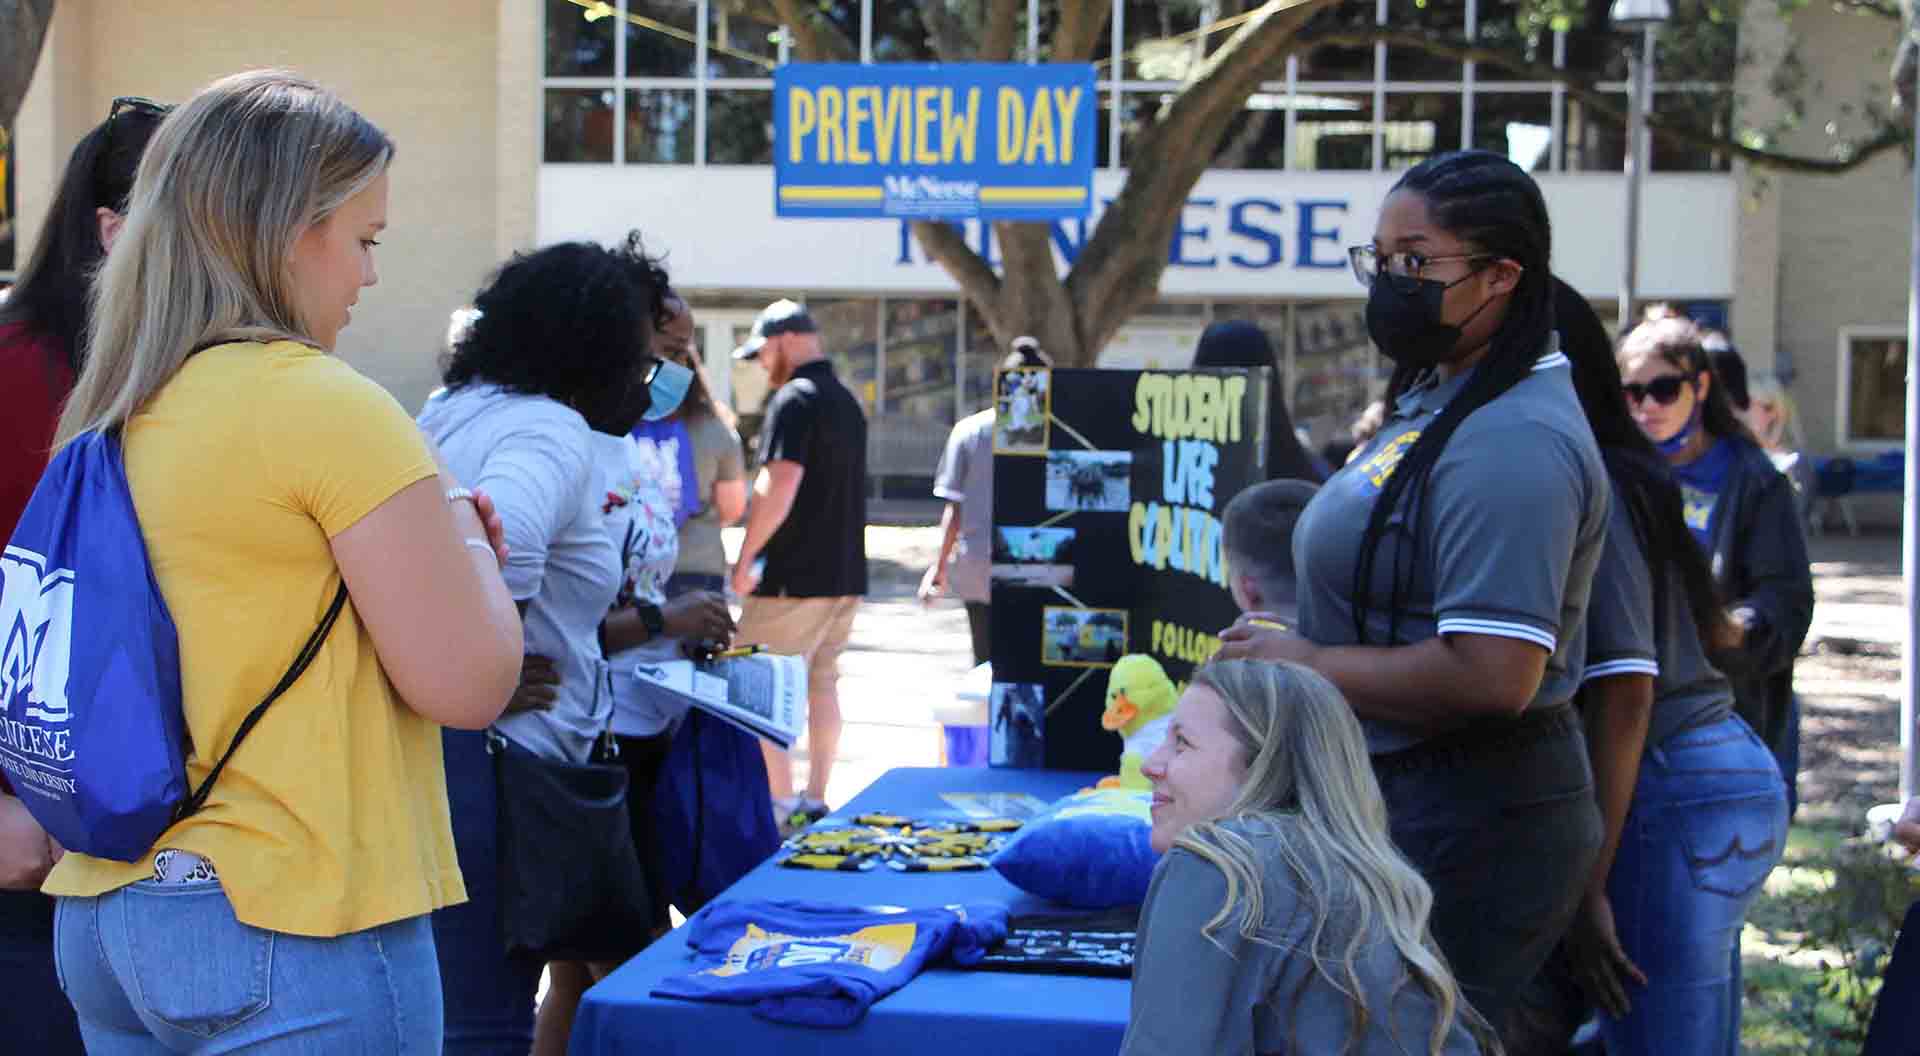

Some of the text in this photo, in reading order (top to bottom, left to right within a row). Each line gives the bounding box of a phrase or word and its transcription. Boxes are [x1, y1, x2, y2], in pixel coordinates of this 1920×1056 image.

[788, 85, 1082, 164] PREVIEW DAY
[1132, 372, 1247, 443] STUDENT
[1163, 439, 1219, 509] LIFE
[1128, 501, 1230, 589] COALITIO
